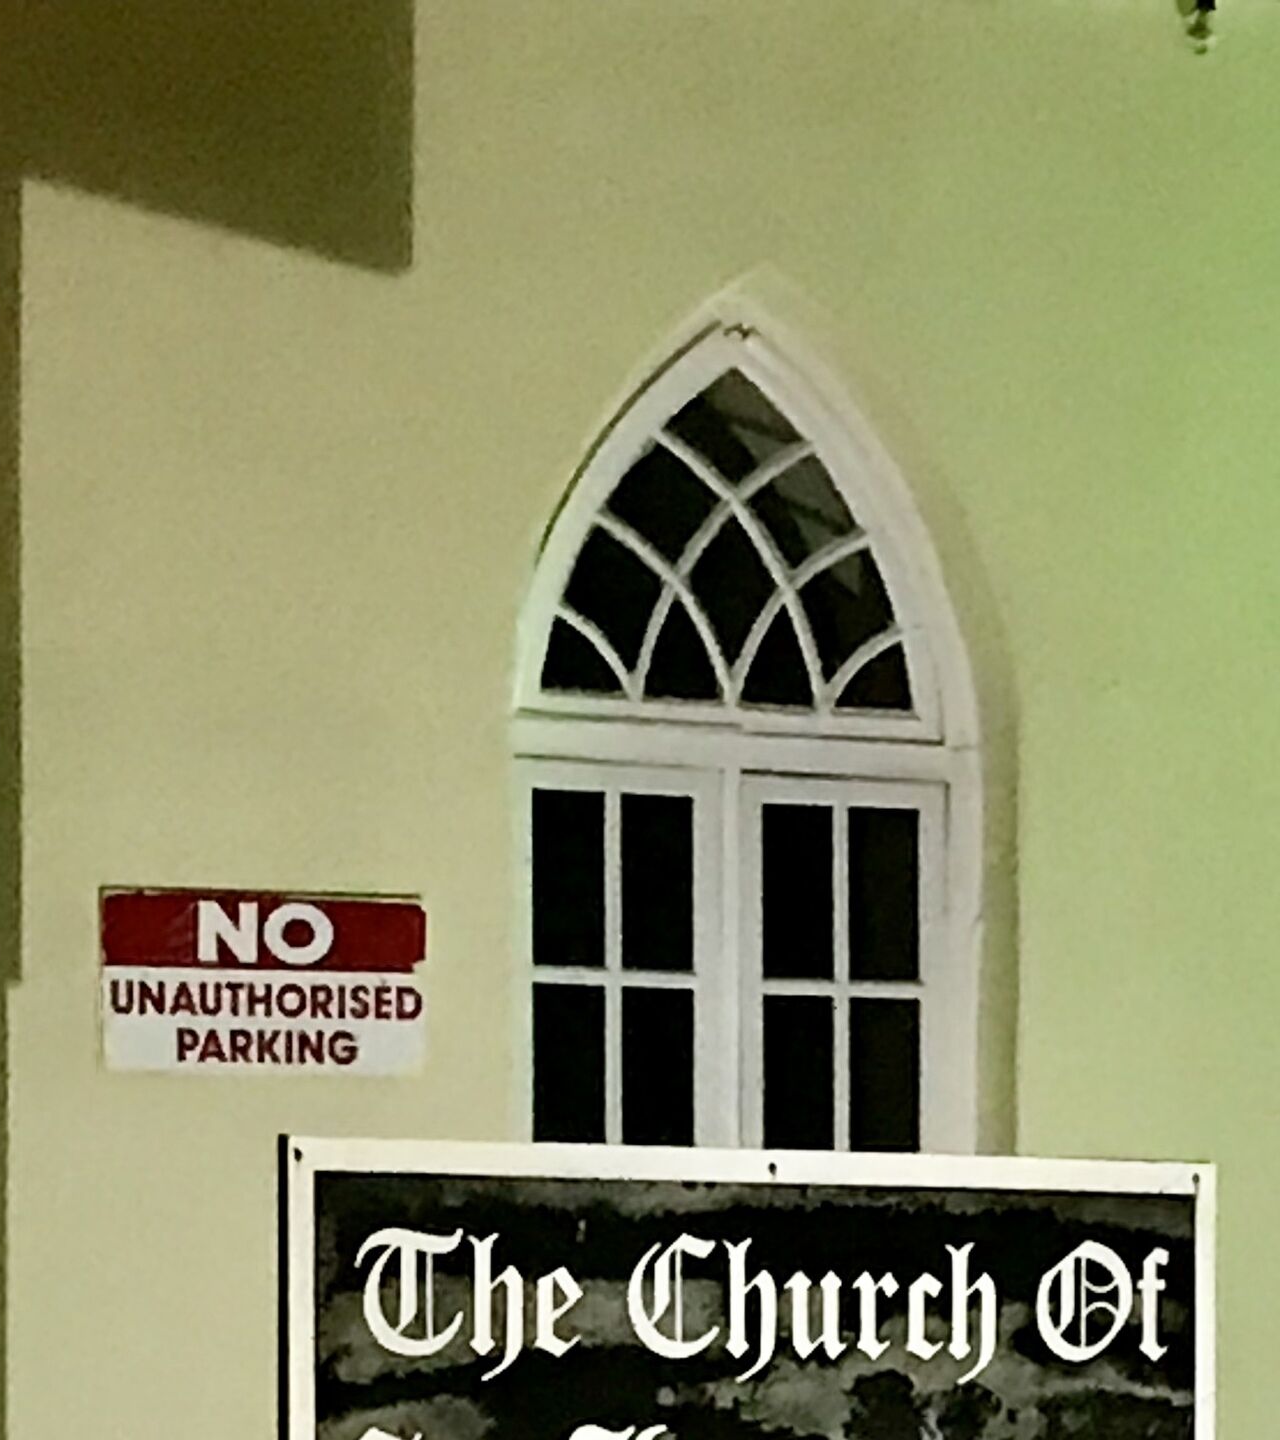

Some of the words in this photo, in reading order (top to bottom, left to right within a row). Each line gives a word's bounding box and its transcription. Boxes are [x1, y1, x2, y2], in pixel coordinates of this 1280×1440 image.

[197, 899, 334, 965] NO
[110, 979, 422, 1020] UNAUTHORISED
[176, 1027, 359, 1065] PARKING
[355, 1227, 583, 1381] The
[627, 1233, 997, 1384] Church
[1036, 1240, 1169, 1360] Of
